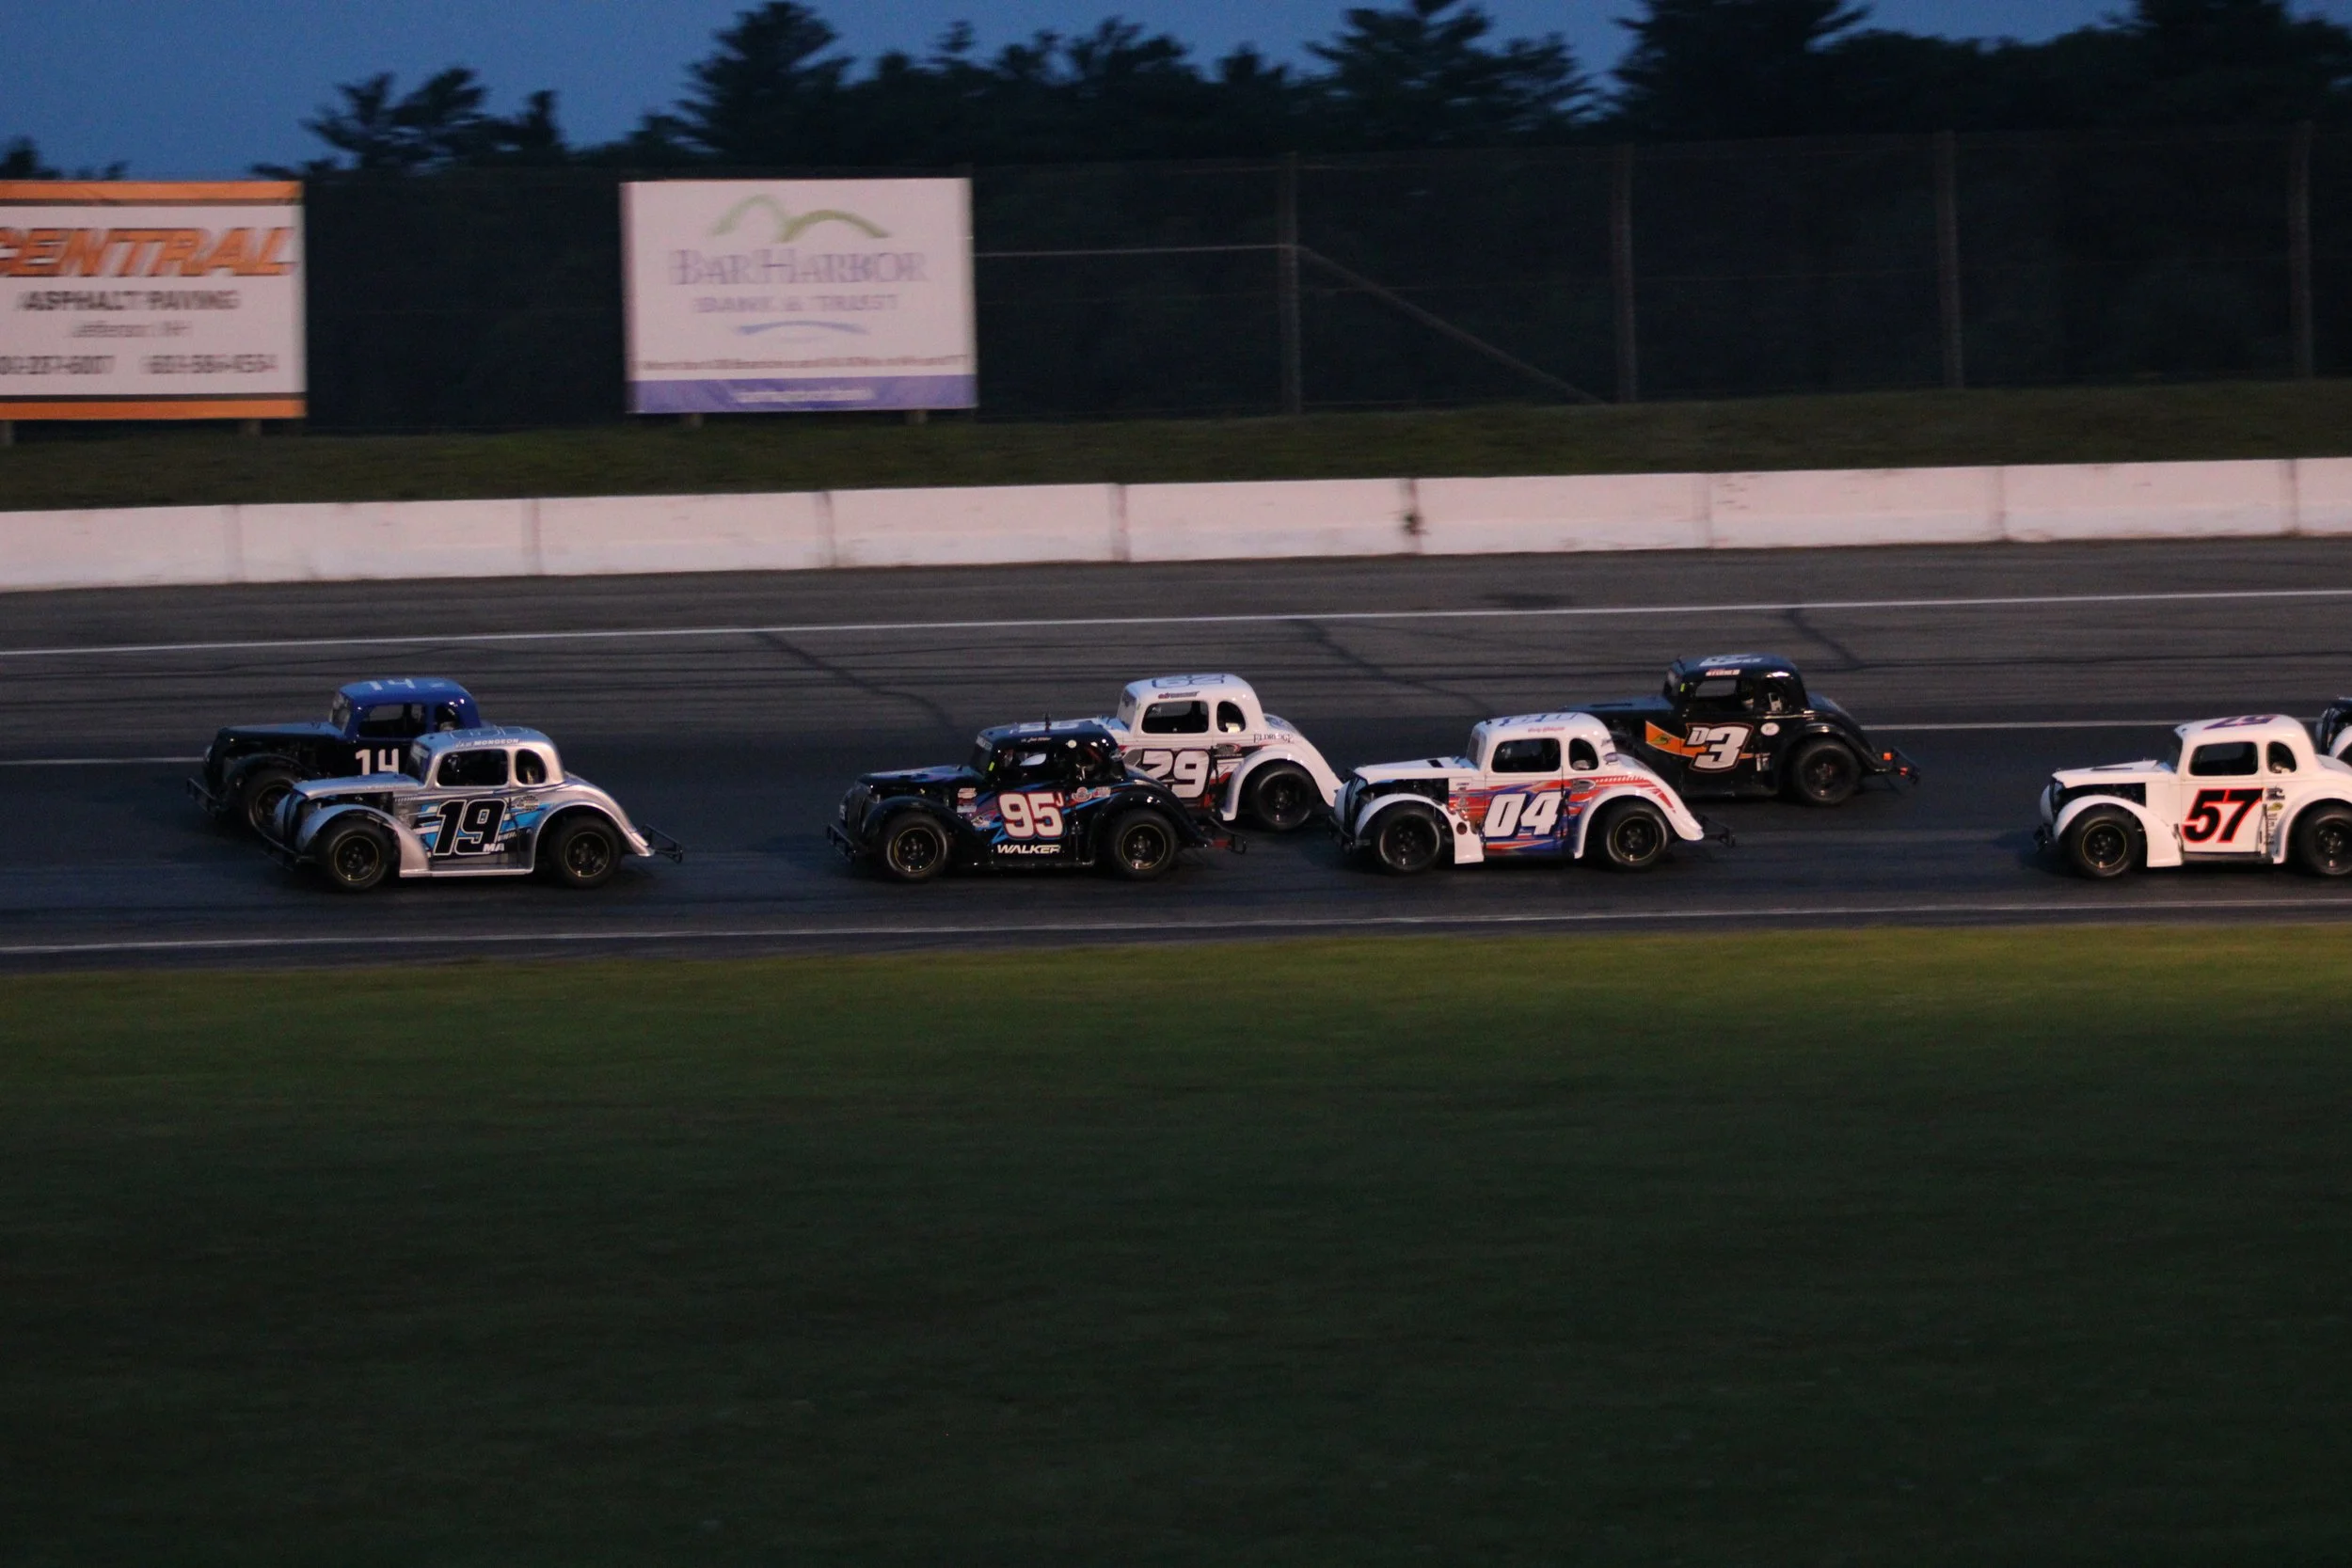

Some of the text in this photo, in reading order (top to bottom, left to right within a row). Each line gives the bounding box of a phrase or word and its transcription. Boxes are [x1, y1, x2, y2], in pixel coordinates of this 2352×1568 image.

[355, 748, 400, 775] 14
[1141, 748, 1209, 799] 29
[434, 799, 507, 856] 19
[1484, 791, 1563, 838] 04
[2182, 787, 2265, 844] 57
[997, 844, 1061, 854] WALKER
